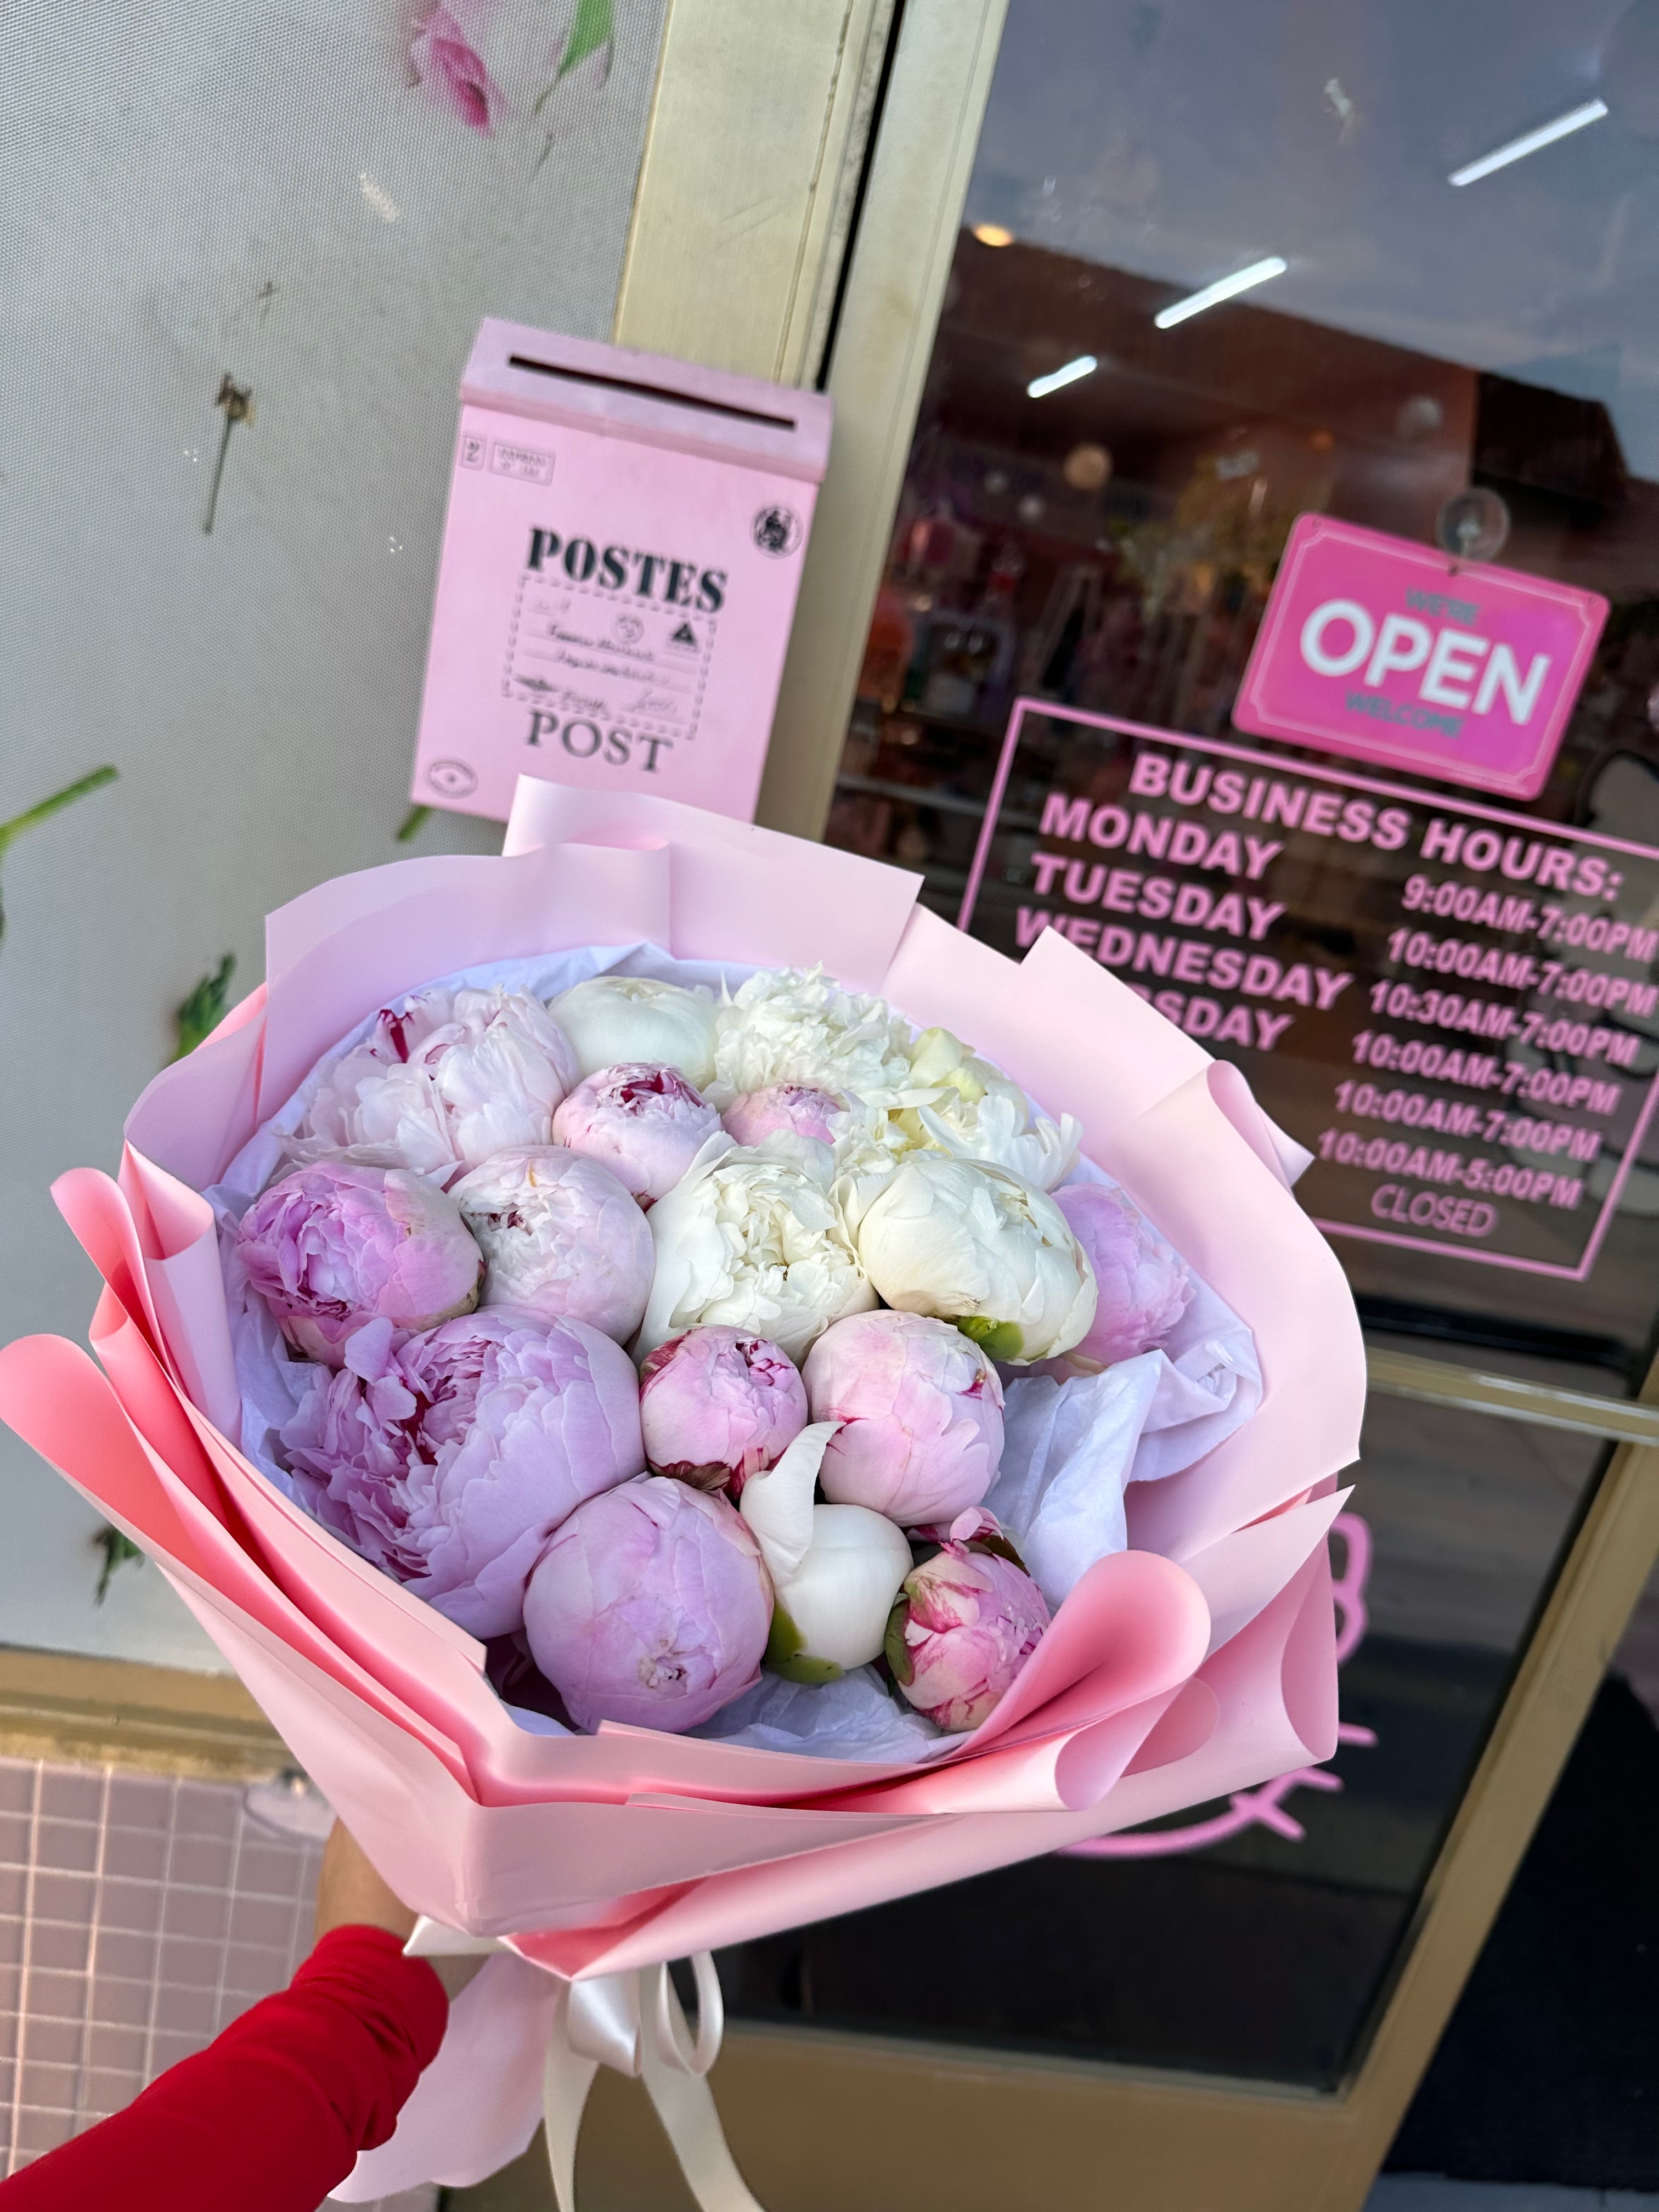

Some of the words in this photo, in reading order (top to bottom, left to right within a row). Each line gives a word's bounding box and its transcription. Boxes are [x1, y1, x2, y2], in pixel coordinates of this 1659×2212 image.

[527, 526, 729, 613] POSTES
[1300, 599, 1551, 725] OPEN
[527, 708, 674, 773] POST
[1346, 691, 1464, 739] WELCOME
[1128, 752, 1410, 850] BUSINESS
[1420, 819, 1623, 901] HOURS:
[1040, 792, 1284, 880] MONDAY
[1402, 874, 1658, 962] 9:00AM-7:00PM
[1031, 851, 1288, 940] TUESDAY
[1388, 928, 1658, 1017] 10:00AM-7:00PM
[1126, 982, 1295, 1050] SDAY
[1351, 1030, 1621, 1115] 10:00AM-7:00PM
[1370, 979, 1641, 1066] 10:30AM-7:00PM
[1335, 1080, 1601, 1161] 10:00AM-7:00PM
[1318, 1128, 1583, 1209] 10:00AM-5:00PM
[1372, 1183, 1497, 1237] CLOSED
